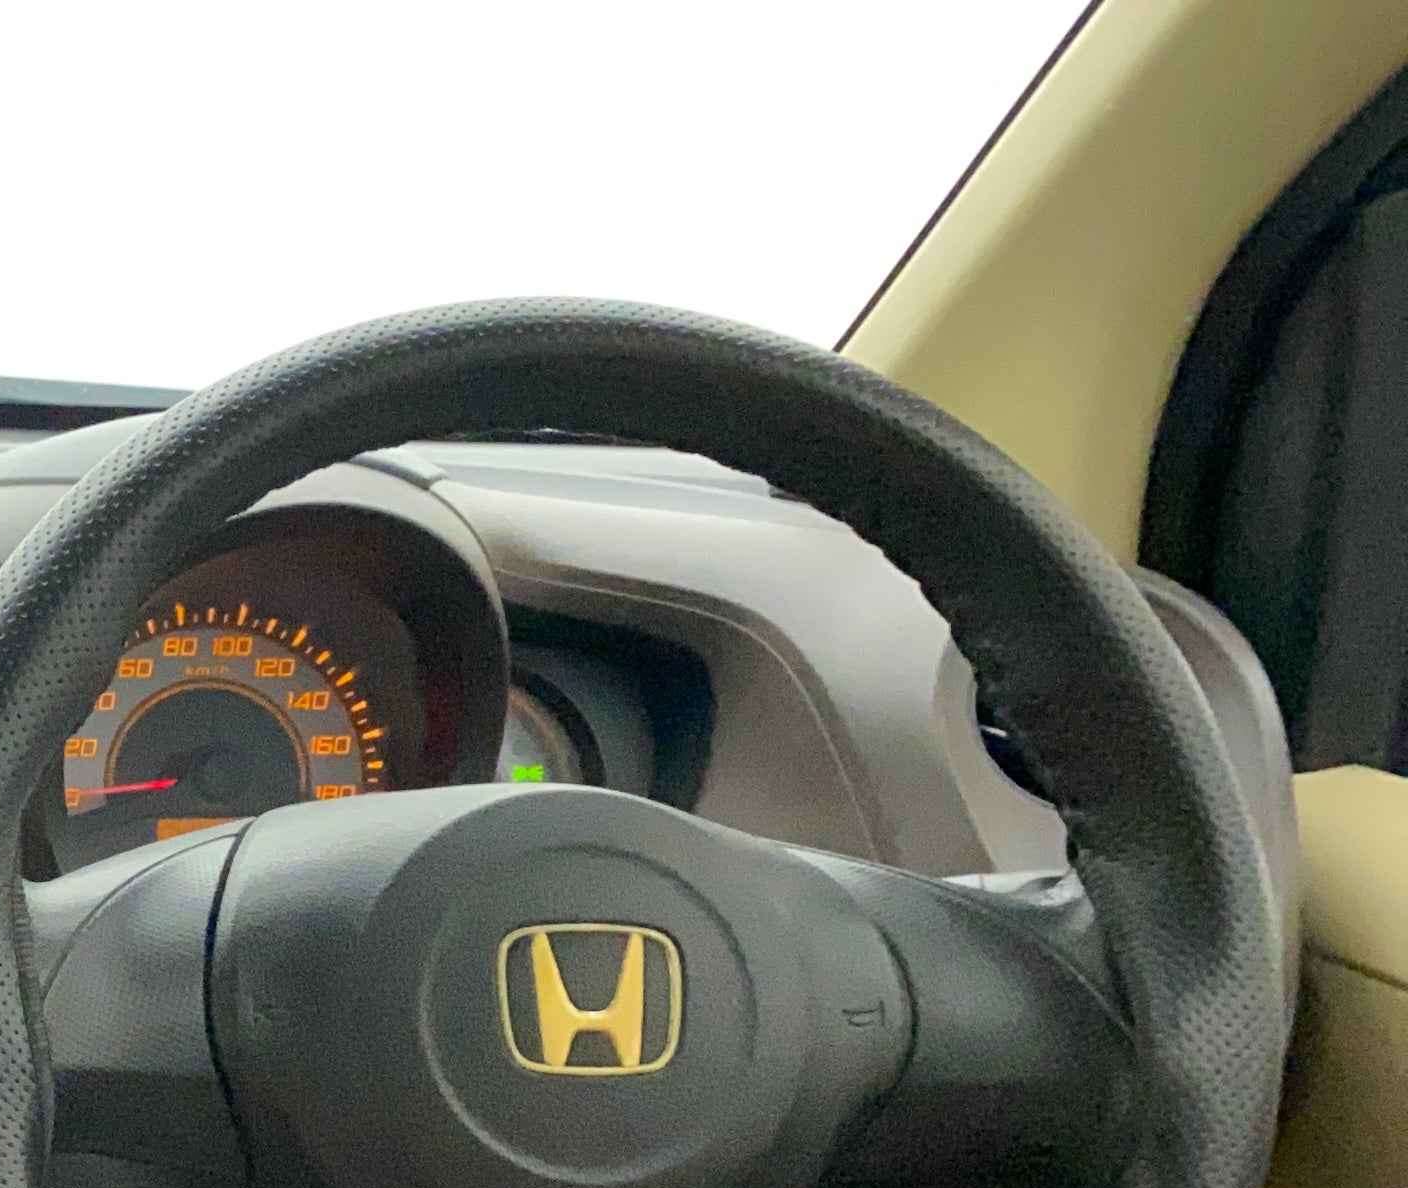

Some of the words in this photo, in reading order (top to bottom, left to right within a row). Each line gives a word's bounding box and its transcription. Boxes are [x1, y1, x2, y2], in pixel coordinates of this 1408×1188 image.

[162, 637, 198, 657] 80
[212, 636, 253, 656] 100
[117, 659, 154, 678] 60
[186, 665, 230, 676] km/h
[254, 658, 296, 678] 120
[94, 691, 117, 711] 0
[287, 691, 331, 710] 140
[64, 738, 98, 757] 20
[311, 735, 351, 755] 160
[315, 784, 356, 800] 180
